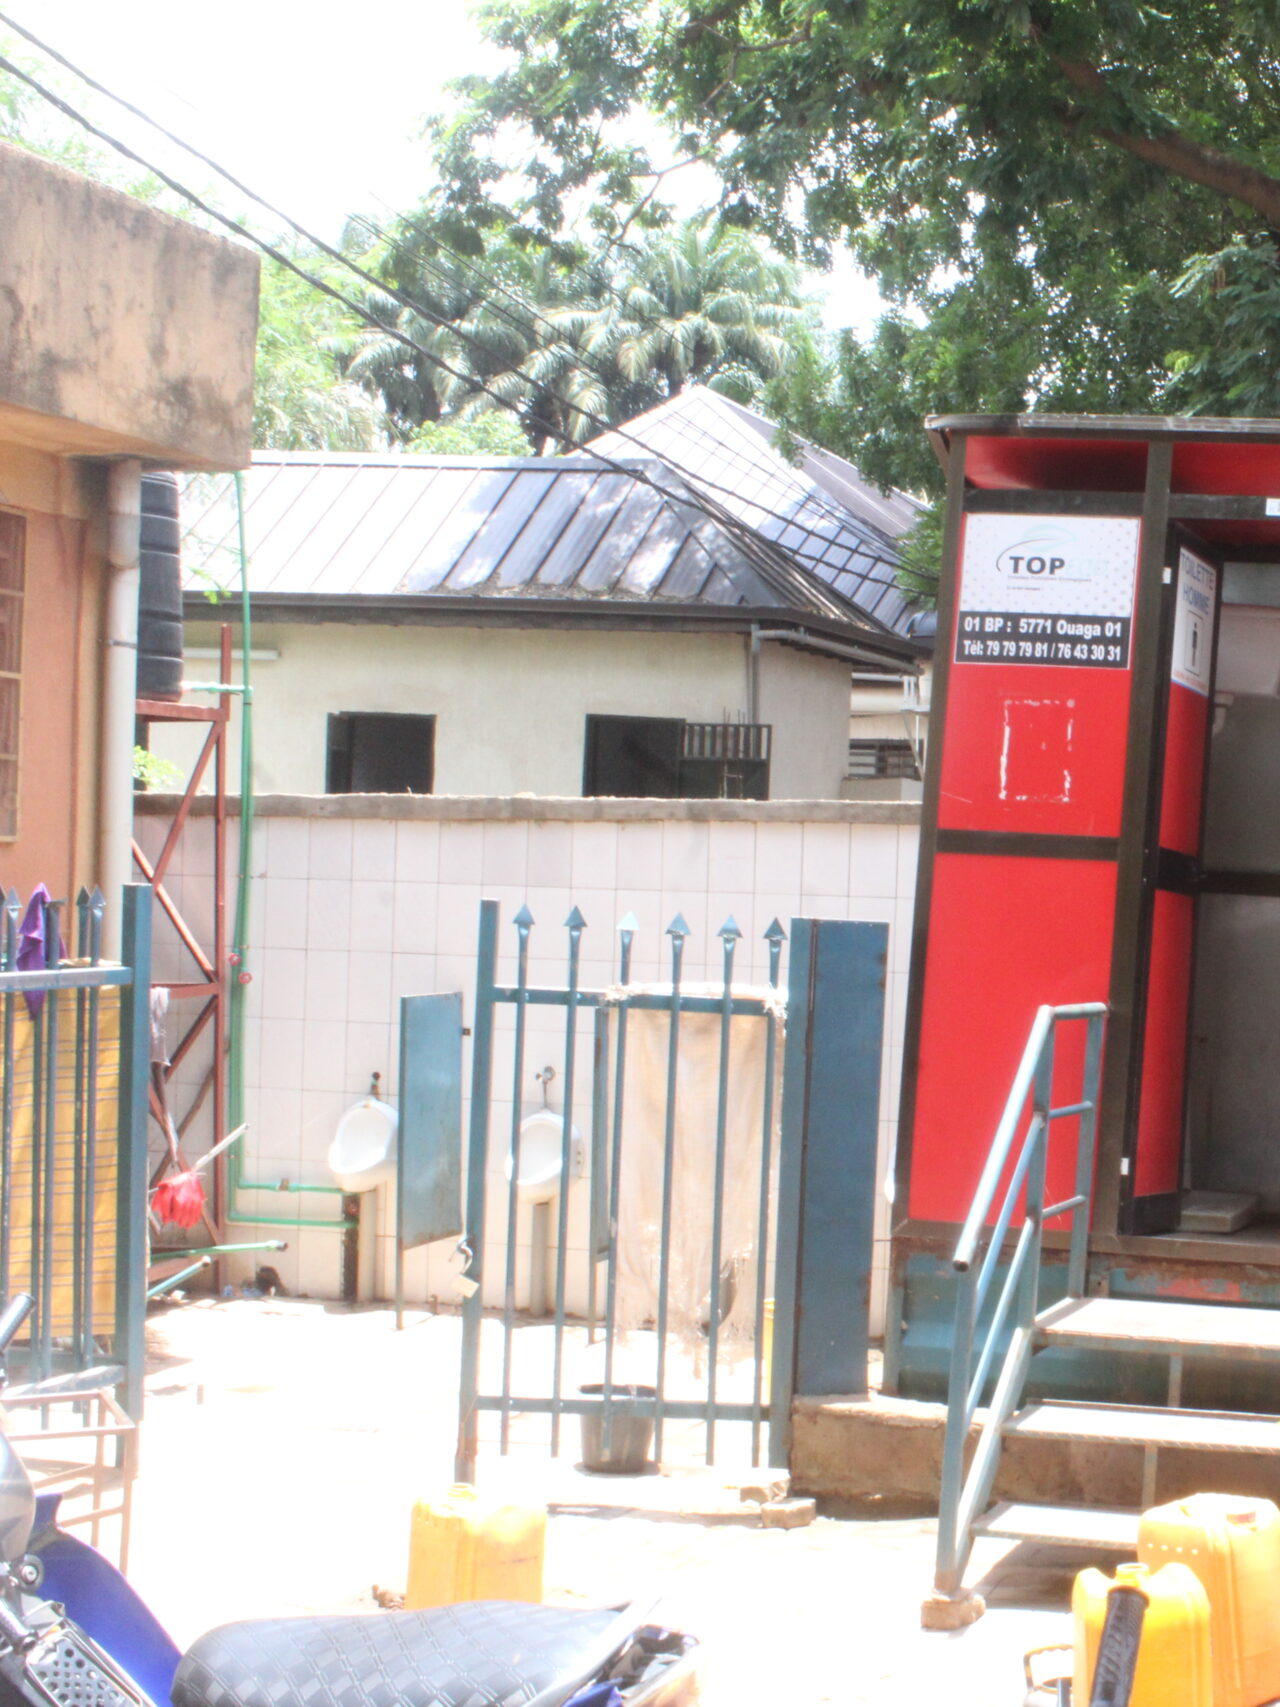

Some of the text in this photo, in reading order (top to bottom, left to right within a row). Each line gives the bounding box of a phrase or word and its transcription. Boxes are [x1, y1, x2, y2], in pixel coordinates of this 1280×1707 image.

[1180, 551, 1214, 591] TOILETTE
[964, 616, 980, 632] 01
[984, 618, 1003, 632] BP
[1019, 618, 1052, 634] 5771
[1056, 620, 1101, 639] Ouaga
[1104, 622, 1122, 637] 01
[963, 640, 983, 655] Tél:
[986, 641, 1000, 656] 79
[1002, 641, 1016, 657] 79
[1018, 642, 1032, 657] 79
[1034, 643, 1048, 658] 81
[1057, 643, 1071, 659] 76
[1073, 644, 1088, 660] 43
[1090, 644, 1105, 660] 30
[1107, 645, 1121, 661] 31
